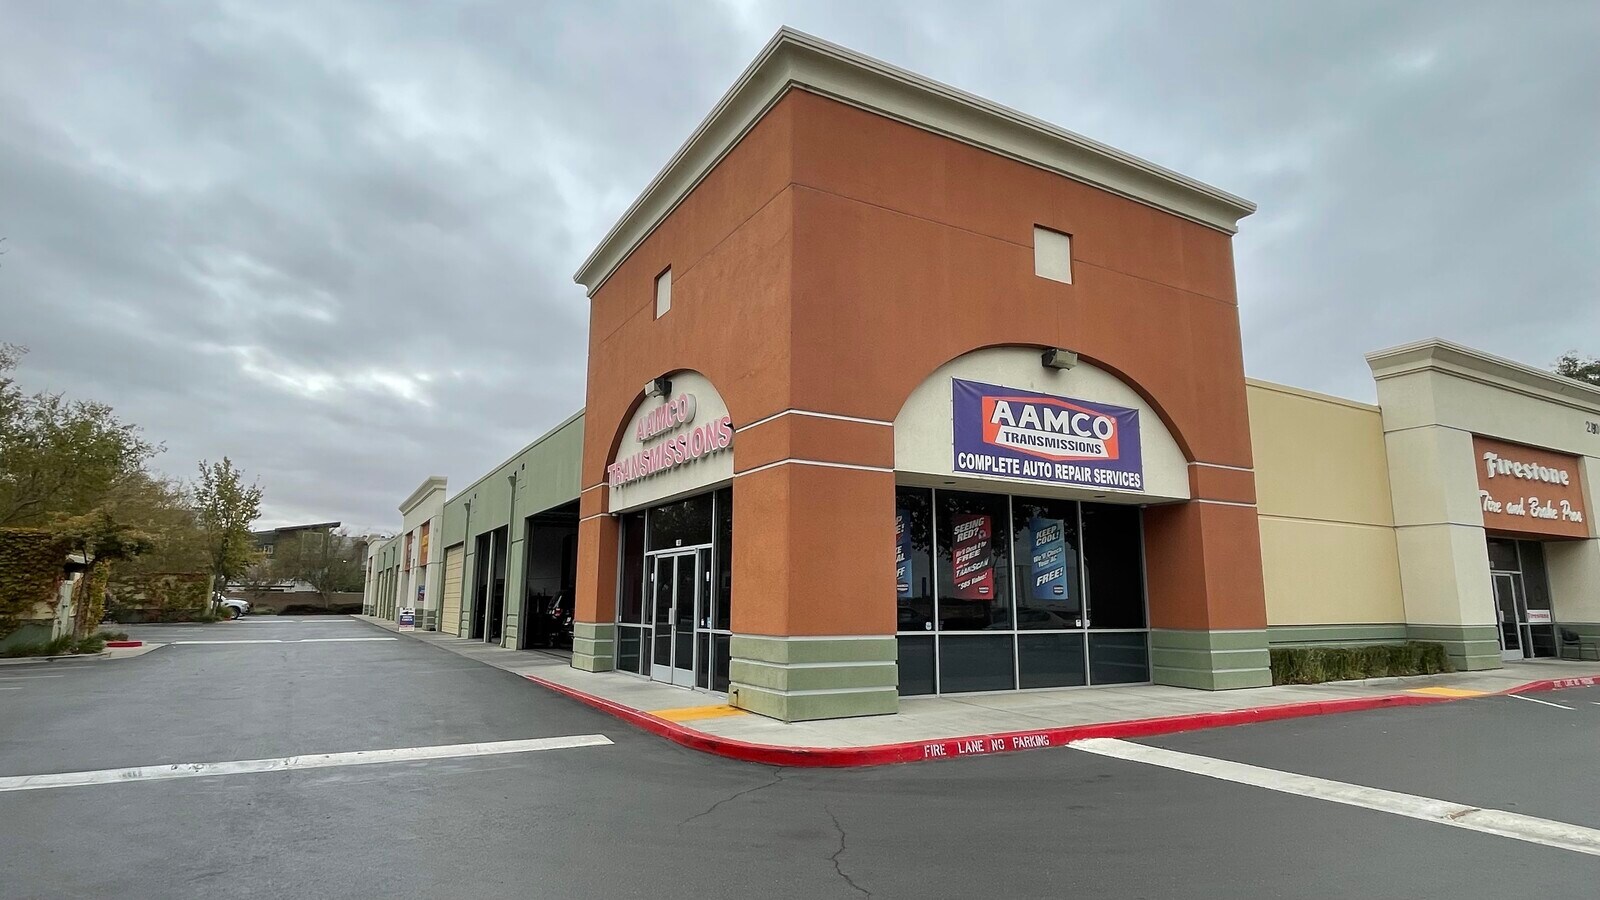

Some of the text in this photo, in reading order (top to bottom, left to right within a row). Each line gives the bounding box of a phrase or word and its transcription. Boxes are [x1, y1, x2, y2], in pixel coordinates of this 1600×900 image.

[636, 392, 694, 443] AAMCO
[991, 400, 1114, 440] AAMCO
[607, 415, 733, 488] TRANSMISSIONS
[1003, 431, 1102, 454] TRANSMISSIONS
[957, 452, 1141, 488] COMPLETE AUTO REPAIR SERVICES
[1483, 451, 1570, 486] Firestone
[1479, 490, 1583, 523] Tire and Brake Pros
[953, 517, 985, 535] SEEING
[956, 527, 980, 543] RED?
[1036, 525, 1057, 540] KEEP
[1036, 531, 1060, 547] COOL!
[956, 549, 981, 565] FREE
[1036, 567, 1064, 587] FREE!
[924, 734, 1050, 758] FIRE LANE NO PARKING
